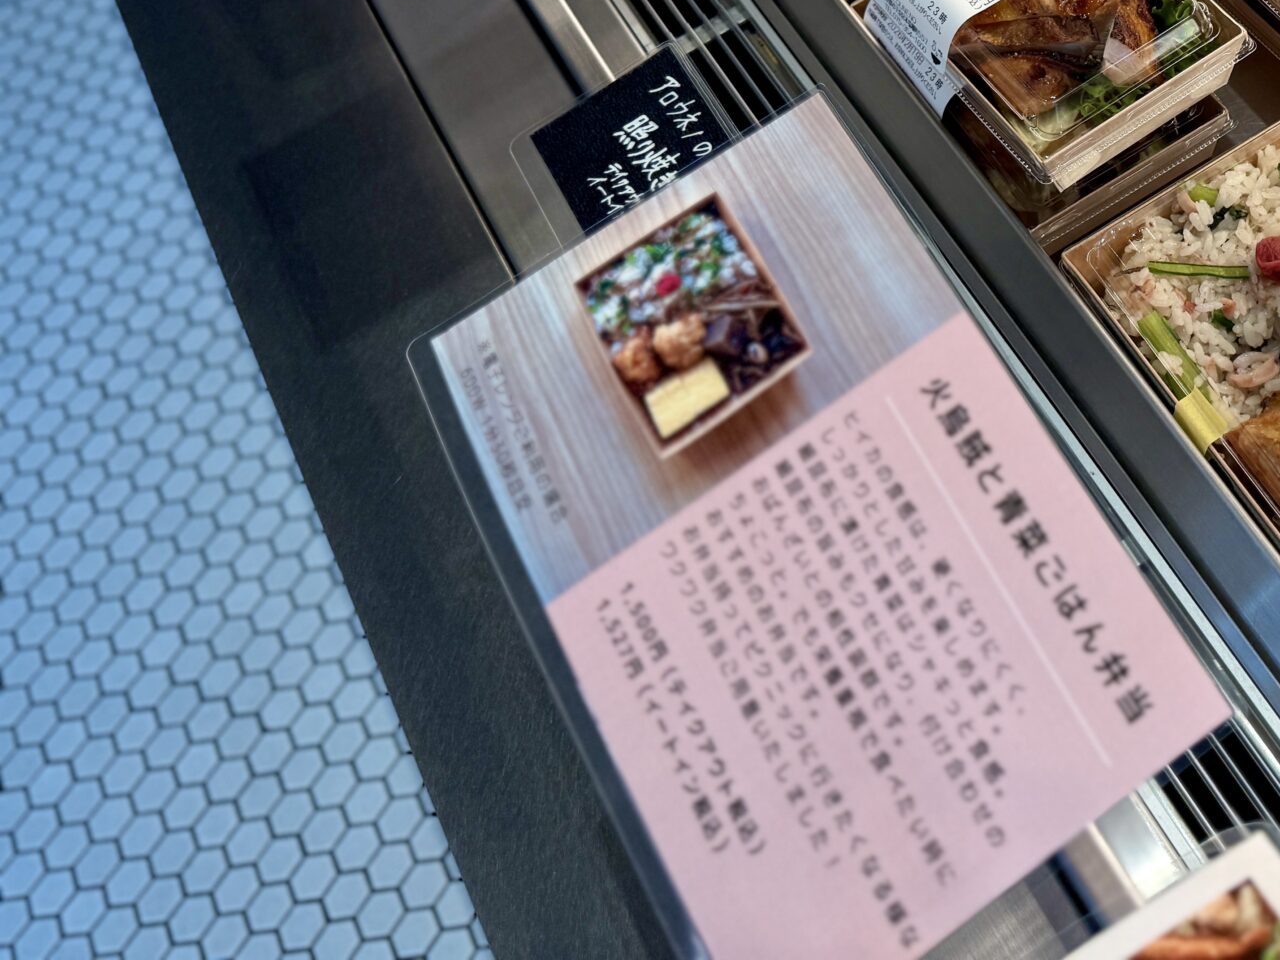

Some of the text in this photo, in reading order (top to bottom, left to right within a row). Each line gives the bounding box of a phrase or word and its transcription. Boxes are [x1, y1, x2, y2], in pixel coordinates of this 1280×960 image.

[924, 0, 950, 25] 23時
[585, 169, 628, 220] イートイ
